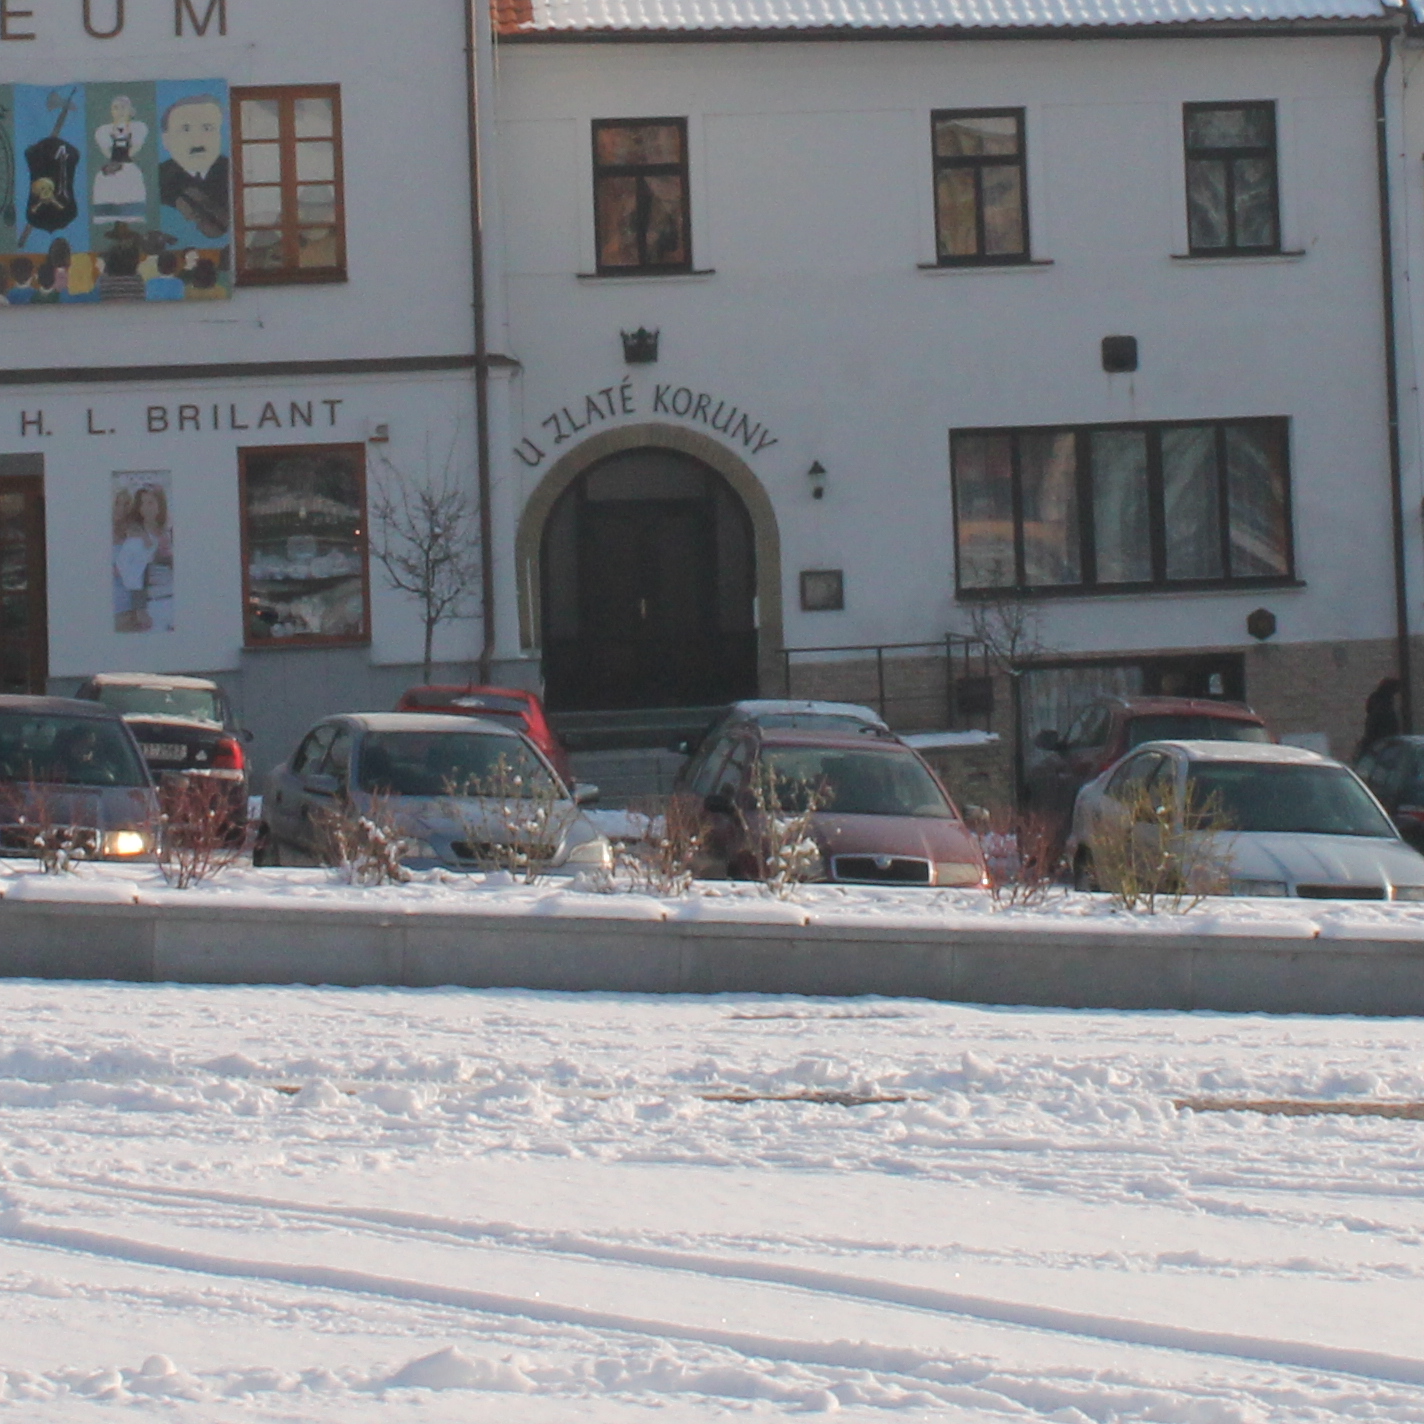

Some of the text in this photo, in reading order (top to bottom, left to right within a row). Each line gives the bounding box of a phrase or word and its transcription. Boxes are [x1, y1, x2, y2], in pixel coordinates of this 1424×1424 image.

[20, 410, 53, 436] H.
[87, 408, 116, 435] L.
[146, 399, 343, 433] BRILANT
[514, 375, 778, 467] U ZLATÉ KORUNY
